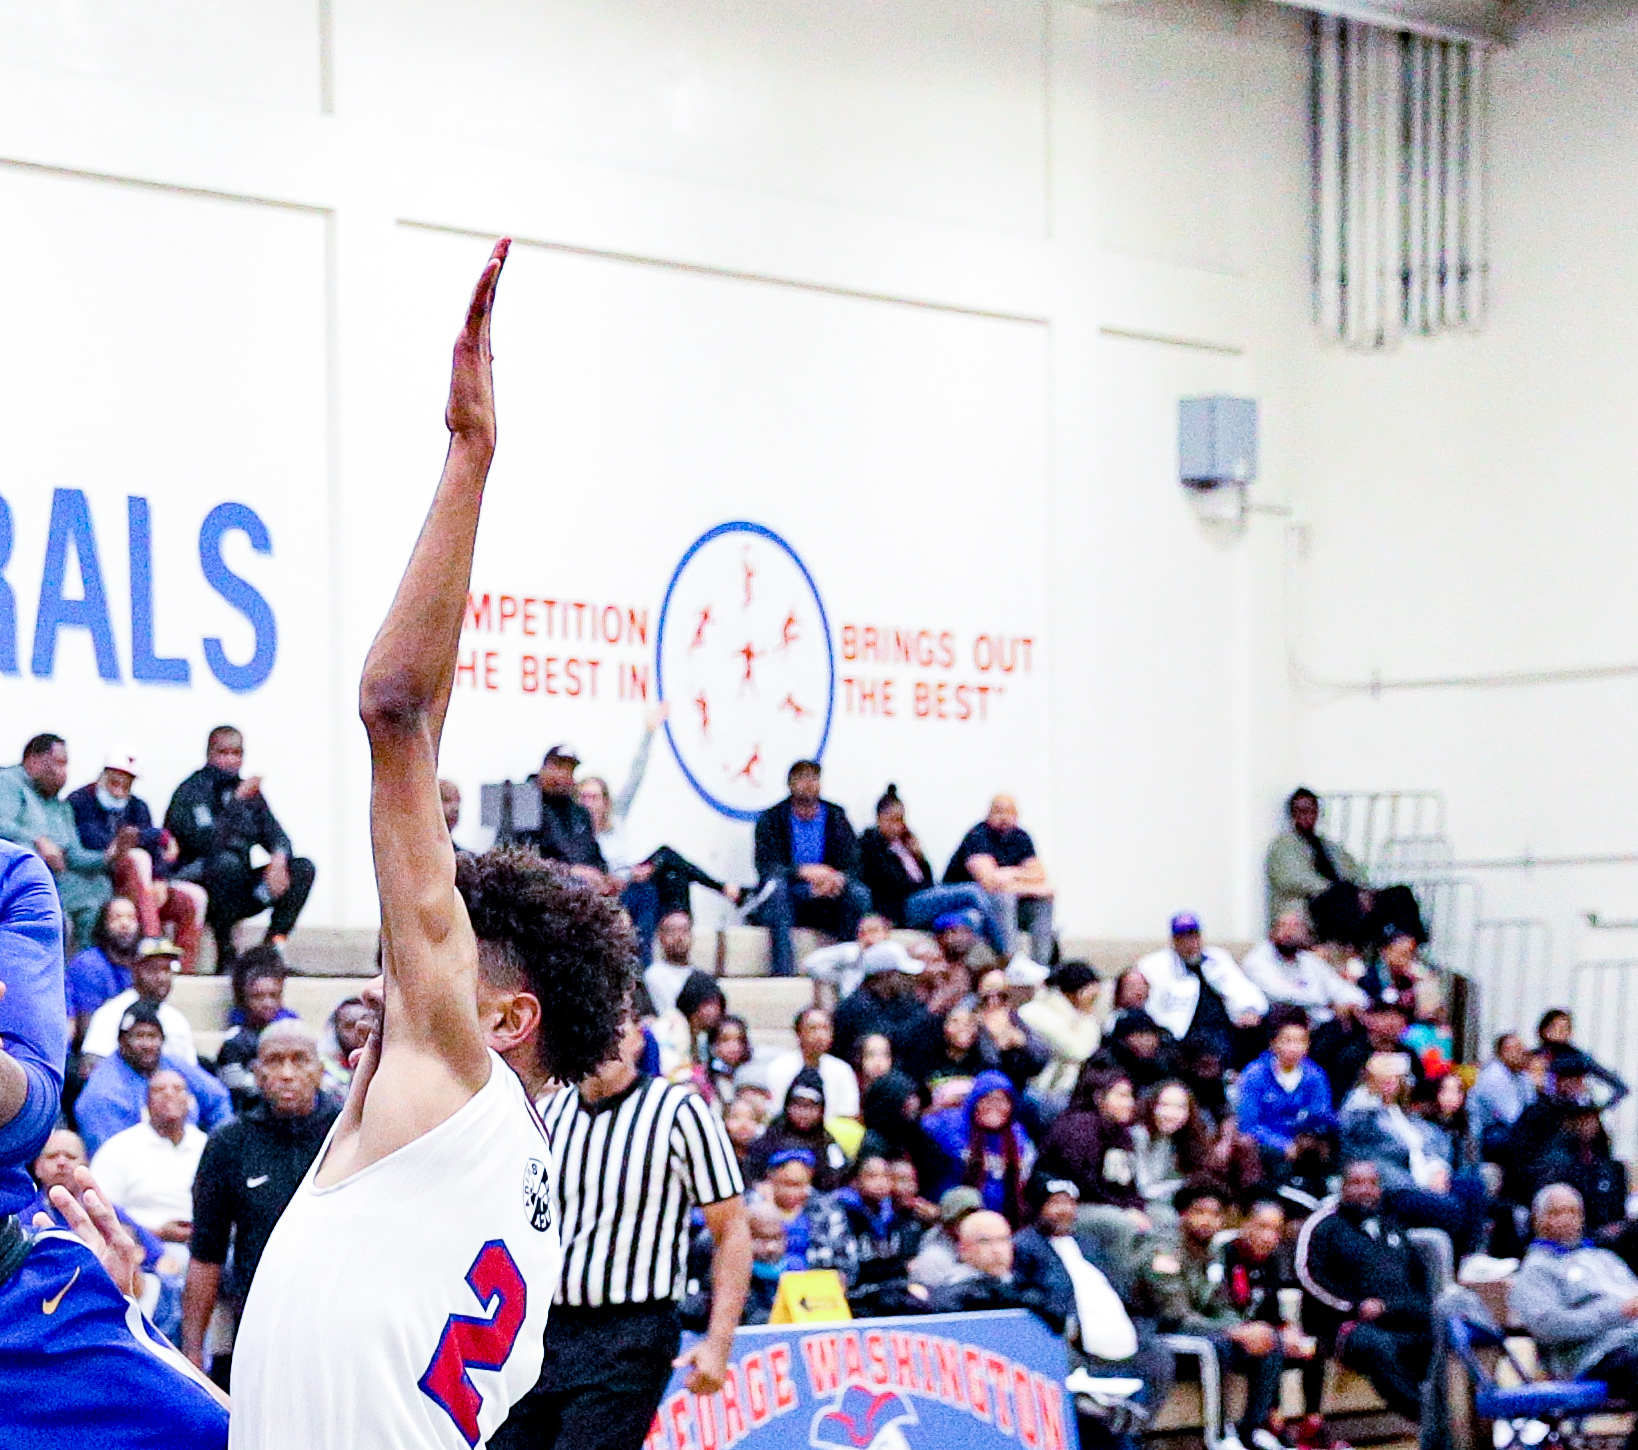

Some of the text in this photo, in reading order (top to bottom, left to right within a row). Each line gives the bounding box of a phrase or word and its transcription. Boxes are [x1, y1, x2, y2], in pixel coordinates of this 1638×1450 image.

[462, 592, 1034, 674] MPETITION BRINGS OUT
[456, 650, 649, 700] HE BEST IN
[844, 678, 895, 717] THE
[418, 1238, 527, 1450] 2
